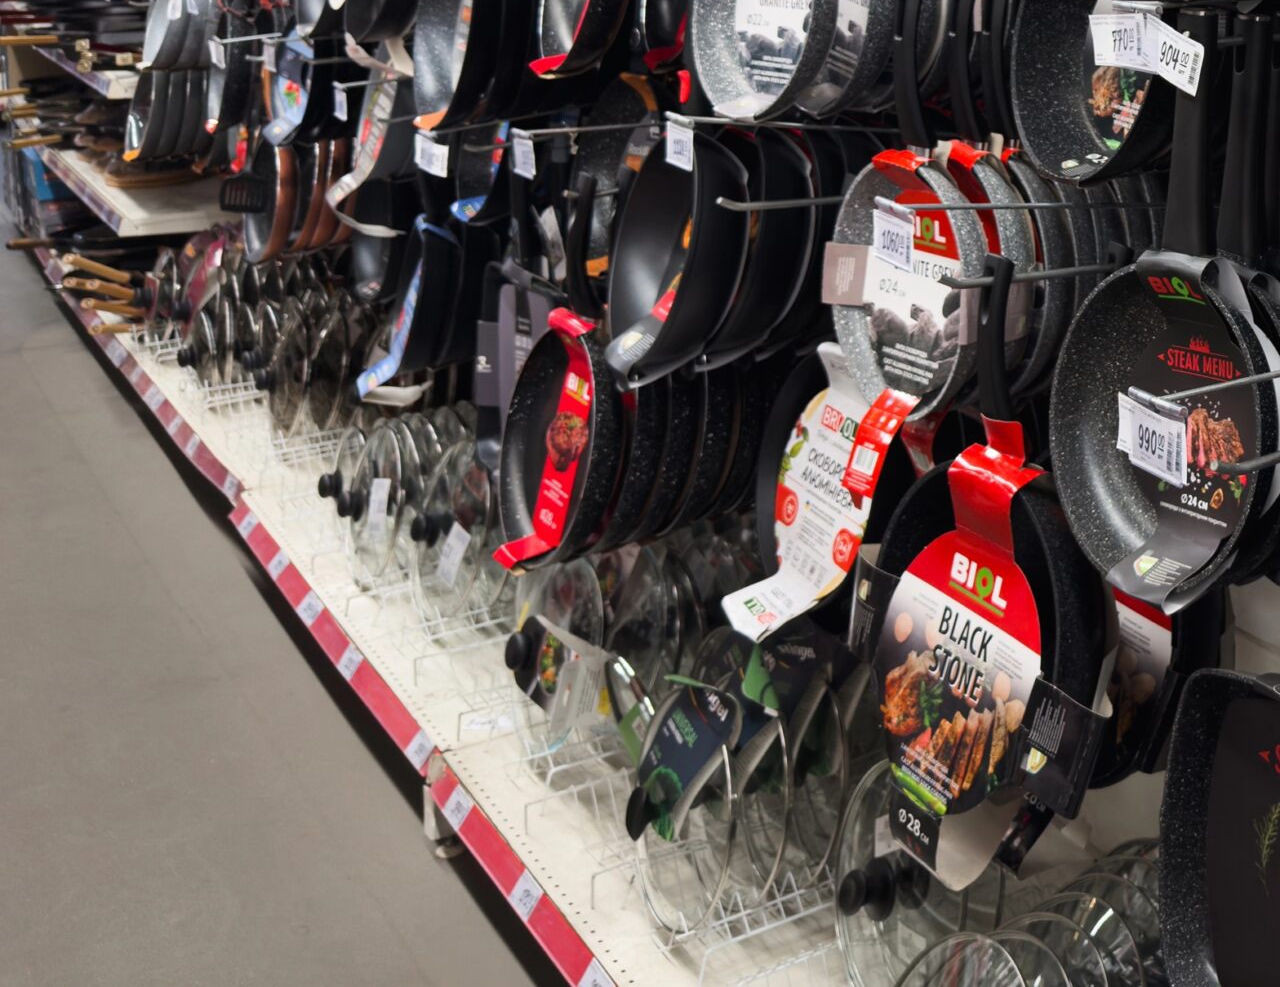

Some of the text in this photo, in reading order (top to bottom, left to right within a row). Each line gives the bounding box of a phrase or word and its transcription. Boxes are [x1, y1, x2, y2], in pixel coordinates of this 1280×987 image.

[1112, 28, 1128, 52] 770
[1160, 41, 1190, 70] 904 00
[881, 229, 899, 254] 1060
[1167, 348, 1233, 379] STEAK MENU
[1137, 423, 1158, 457] 990
[951, 551, 1007, 611] BIOL
[938, 605, 993, 663] BLACK
[928, 643, 984, 706] STONE
[907, 813, 921, 837] 28
